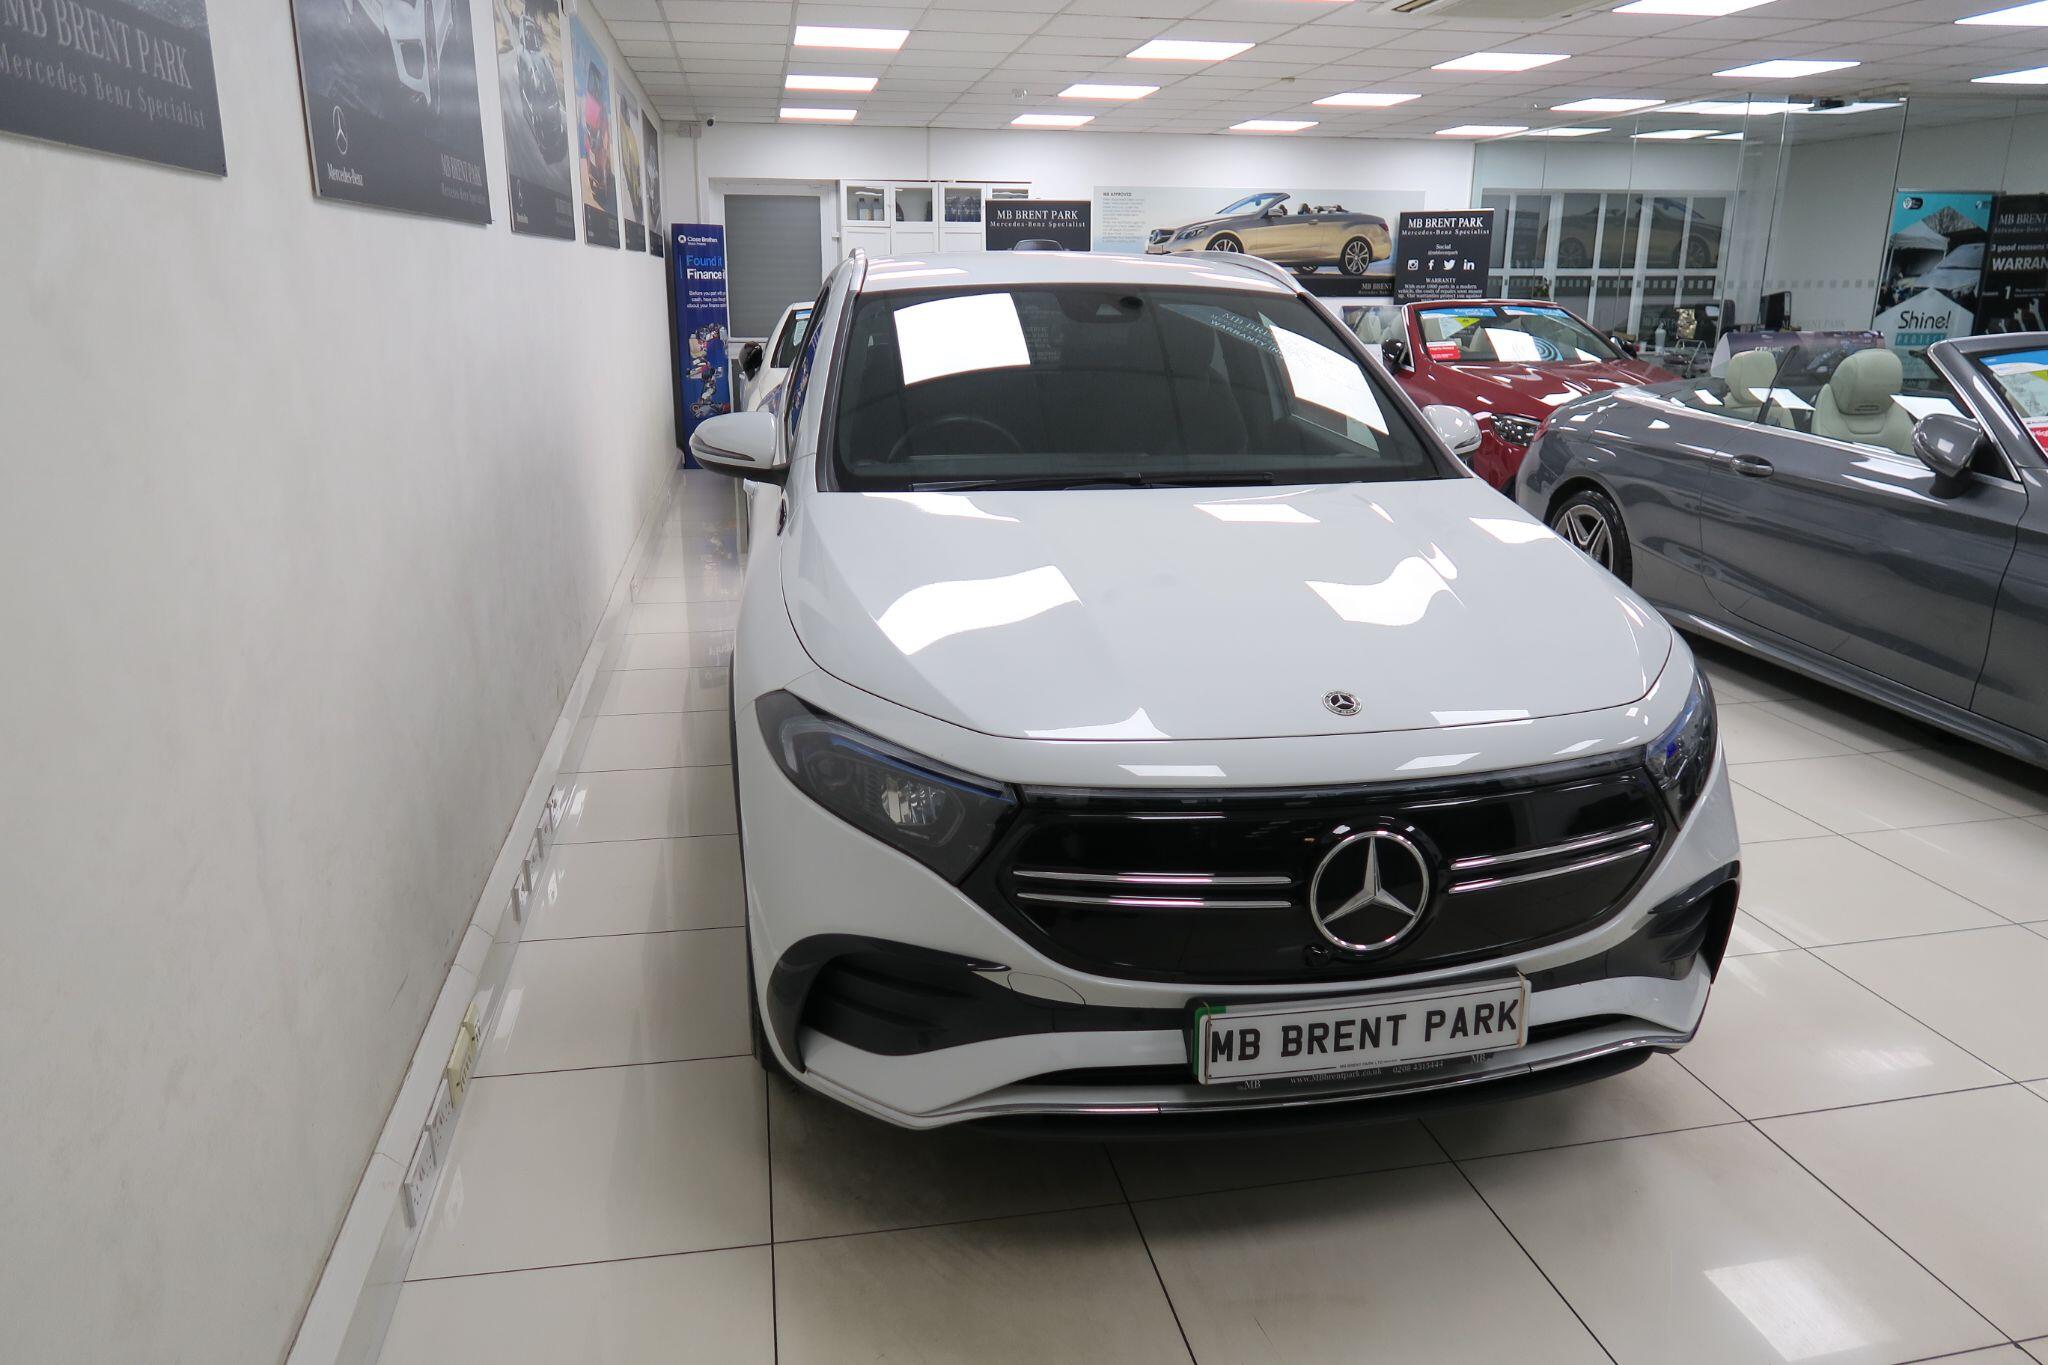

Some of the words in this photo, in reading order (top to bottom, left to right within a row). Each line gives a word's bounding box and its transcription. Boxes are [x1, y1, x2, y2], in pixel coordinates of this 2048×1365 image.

[4, 0, 47, 37] MB
[54, 0, 132, 68] BRENT
[136, 28, 192, 89] PARK
[0, 43, 88, 96] Mercedes
[94, 73, 131, 109] Benz
[137, 86, 207, 128] Specialist
[997, 210, 1012, 220] MB
[1016, 210, 1048, 220] BRENT
[1052, 210, 1078, 220] PARK
[1408, 218, 1423, 228] MB
[1425, 217, 1456, 229] BRENT
[1458, 217, 1483, 228] PARK
[1999, 213, 2015, 225] MB
[687, 255, 716, 266] Found
[717, 256, 722, 266] it
[687, 268, 722, 280] Finance
[1898, 310, 1951, 330] Shine!
[1210, 319, 1267, 346] WARRANTY
[1211, 1028, 1261, 1062] MB
[1281, 1014, 1406, 1057] BRENT
[1425, 999, 1519, 1042] PARK
